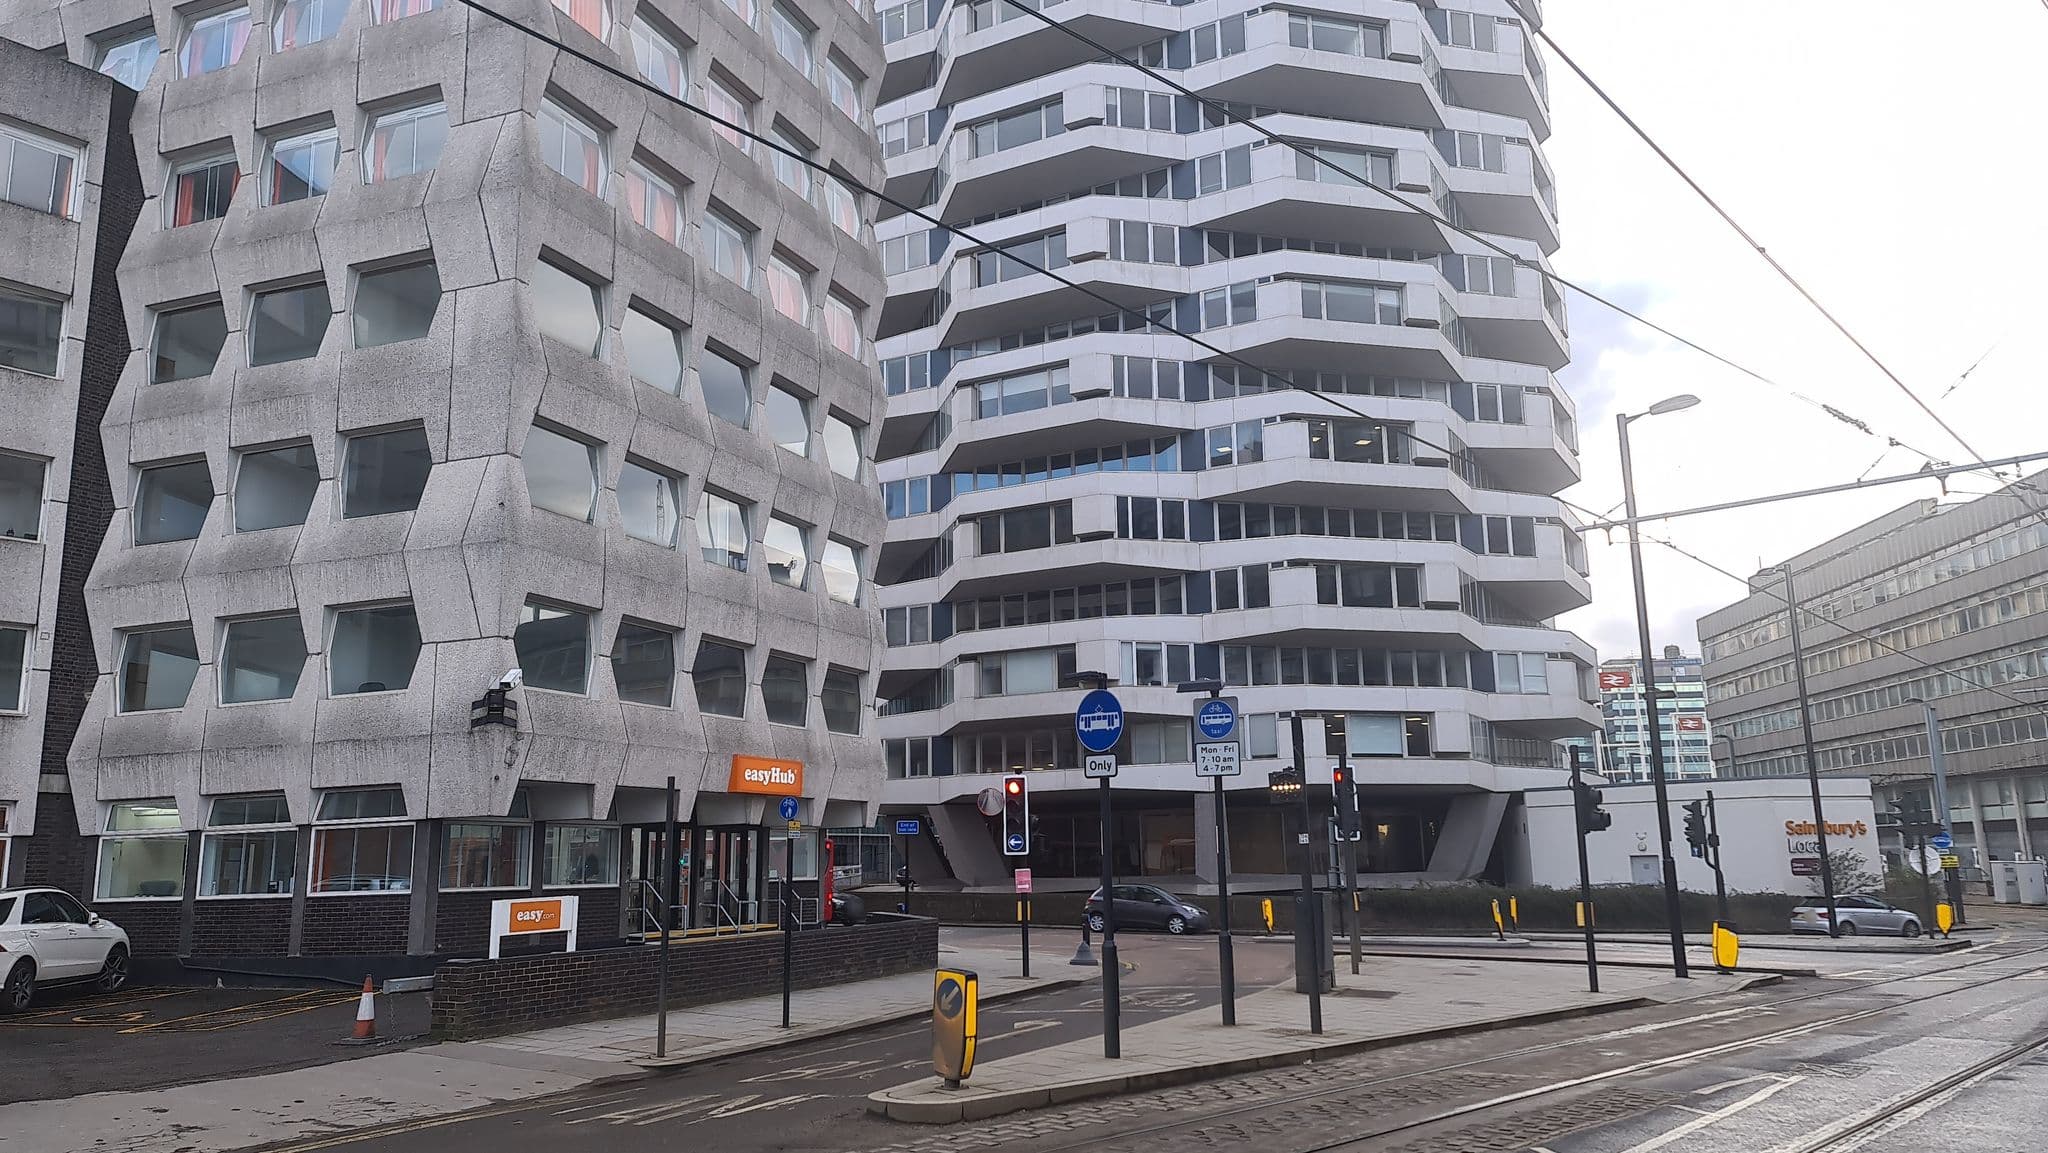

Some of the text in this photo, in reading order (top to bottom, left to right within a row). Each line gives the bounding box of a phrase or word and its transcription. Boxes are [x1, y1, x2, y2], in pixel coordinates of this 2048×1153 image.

[1090, 760, 1112, 771] Only
[744, 767, 796, 785] easyHub
[1785, 820, 1867, 838] Sainbury's
[1787, 838, 1823, 854] Loca
[517, 910, 555, 922] easy.com
